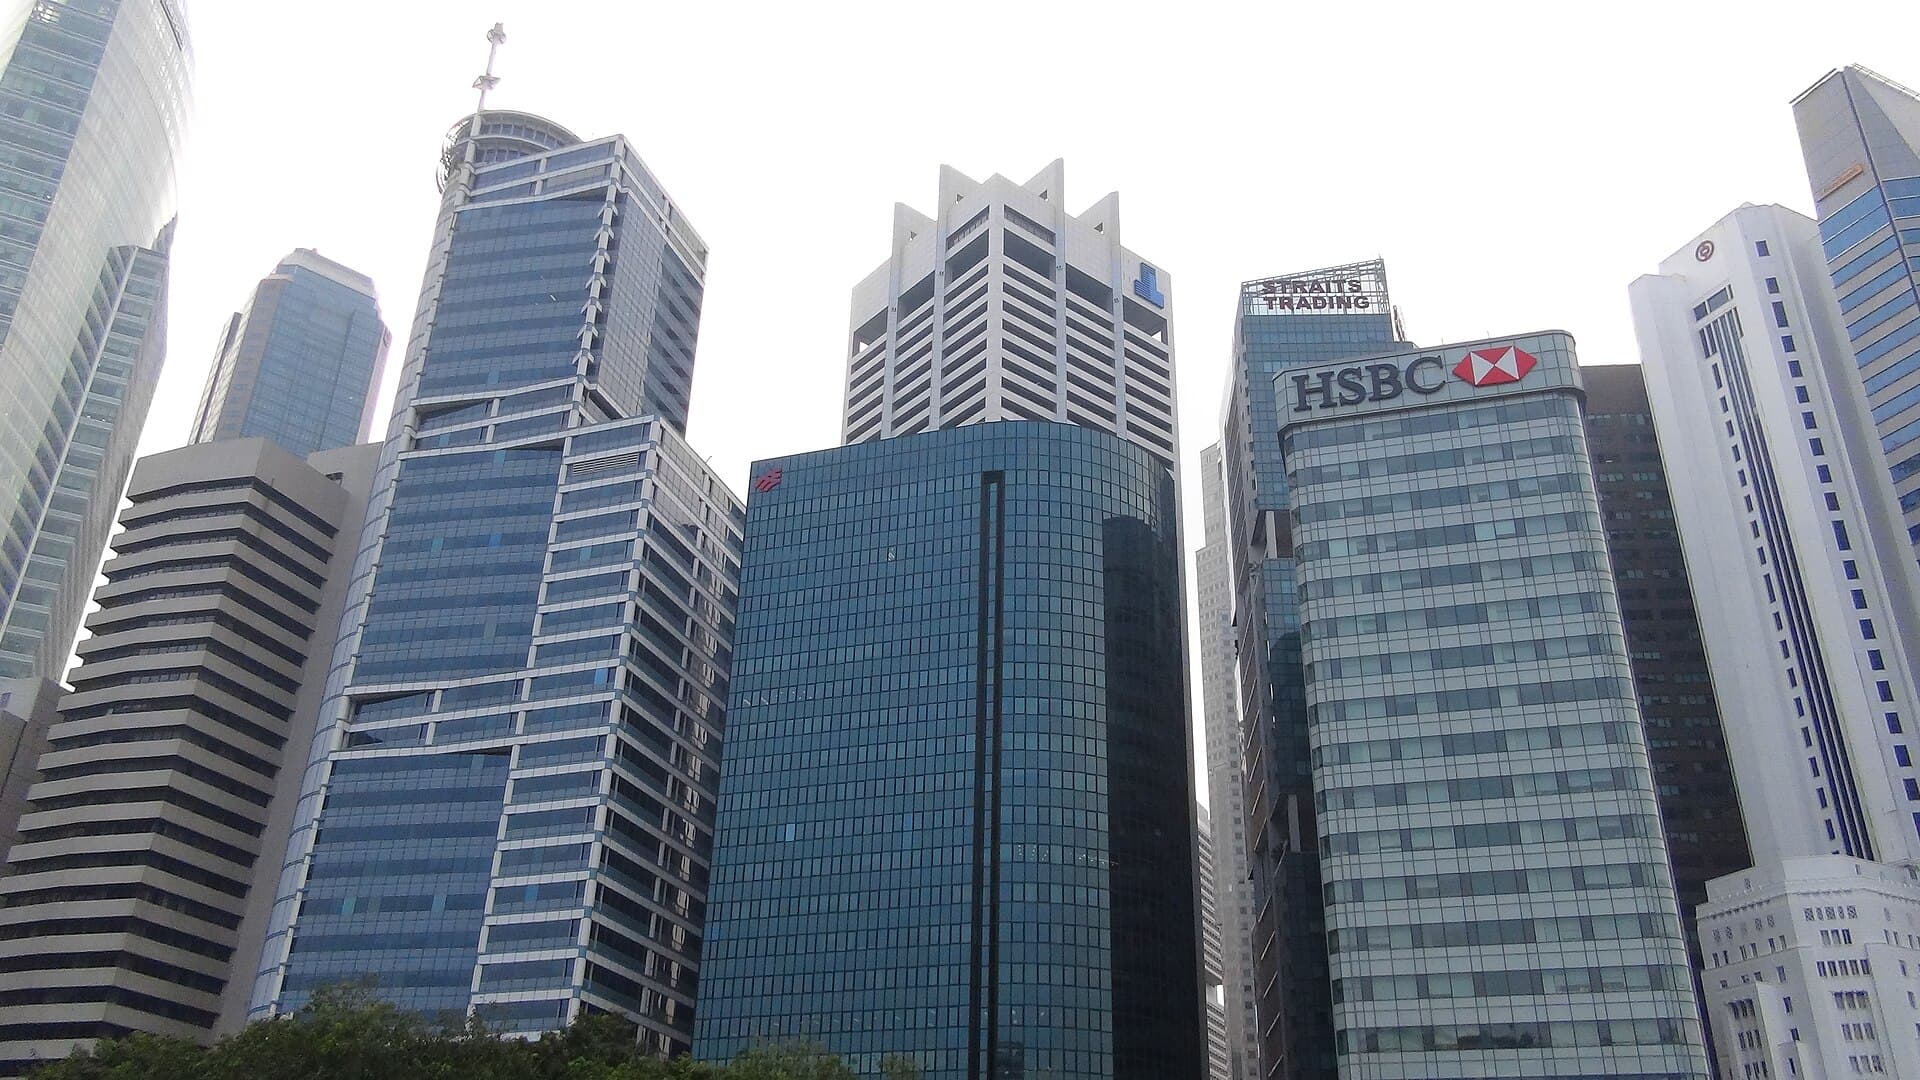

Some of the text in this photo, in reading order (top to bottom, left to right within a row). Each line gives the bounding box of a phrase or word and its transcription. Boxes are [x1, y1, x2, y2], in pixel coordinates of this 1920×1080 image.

[1261, 279, 1362, 295] STRAITS
[1263, 296, 1370, 310] TRADING
[1293, 355, 1446, 412] HSBC
